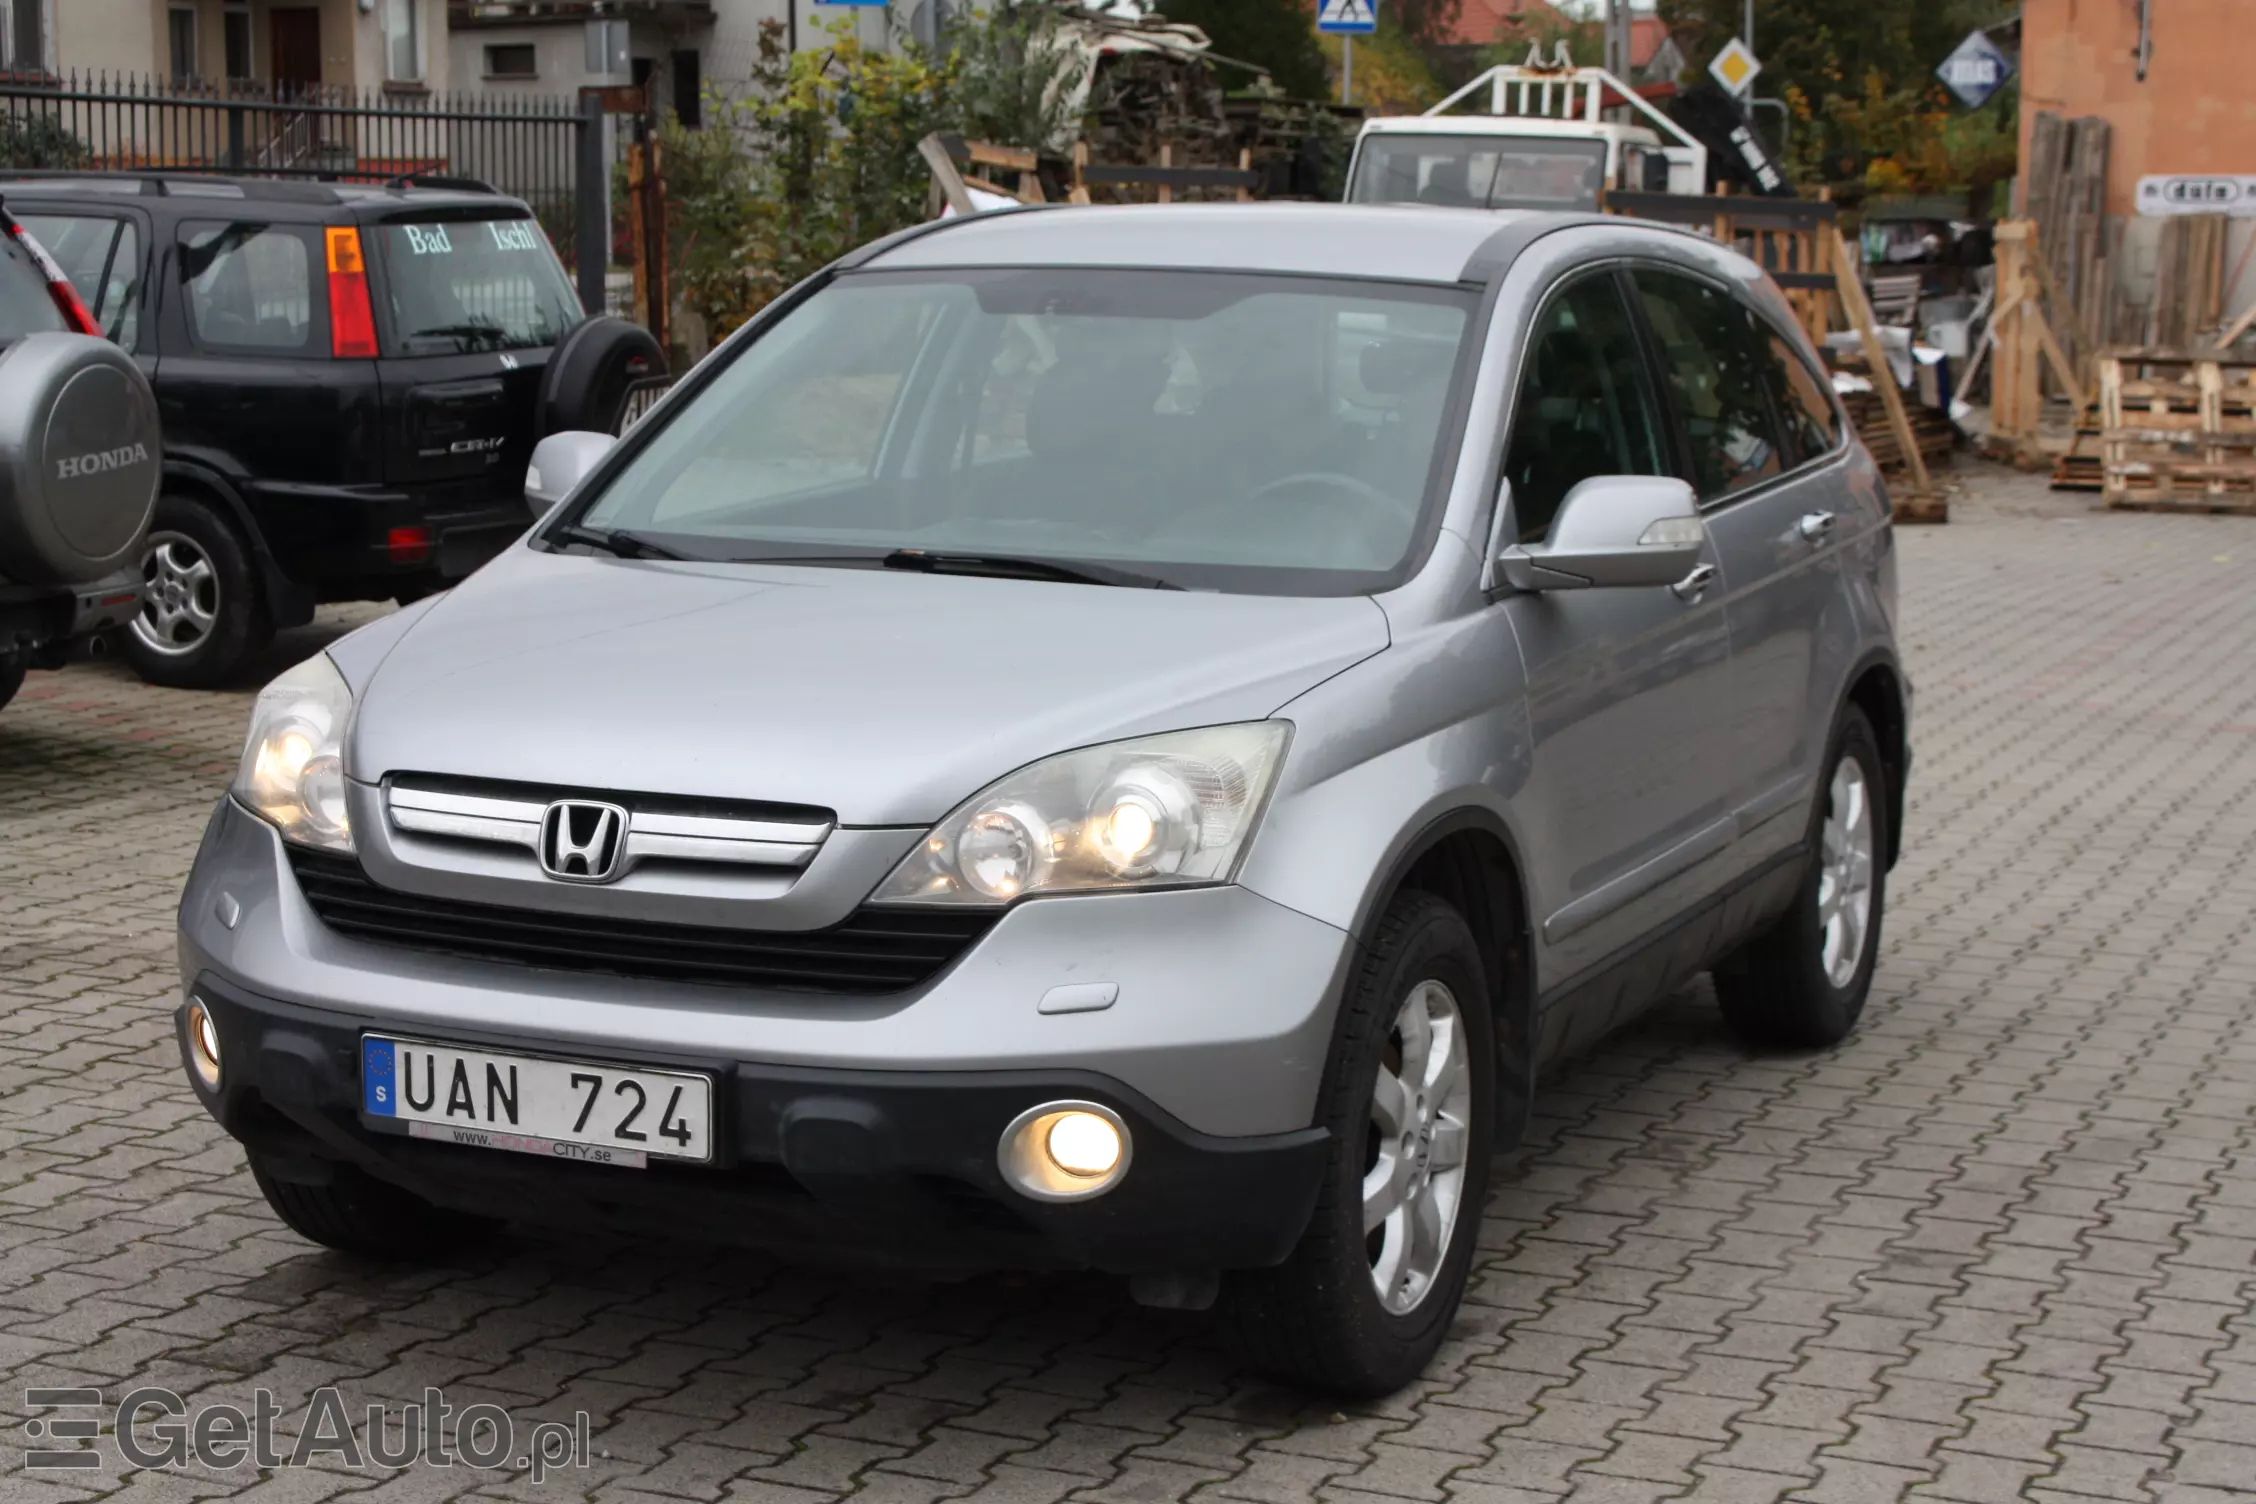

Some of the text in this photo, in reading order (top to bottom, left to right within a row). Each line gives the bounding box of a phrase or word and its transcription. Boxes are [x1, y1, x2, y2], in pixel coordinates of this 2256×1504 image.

[402, 221, 537, 254] Bad Ischl
[57, 442, 148, 478] HONDA
[375, 1085, 387, 1102] S
[404, 1051, 692, 1147] UAN 724
